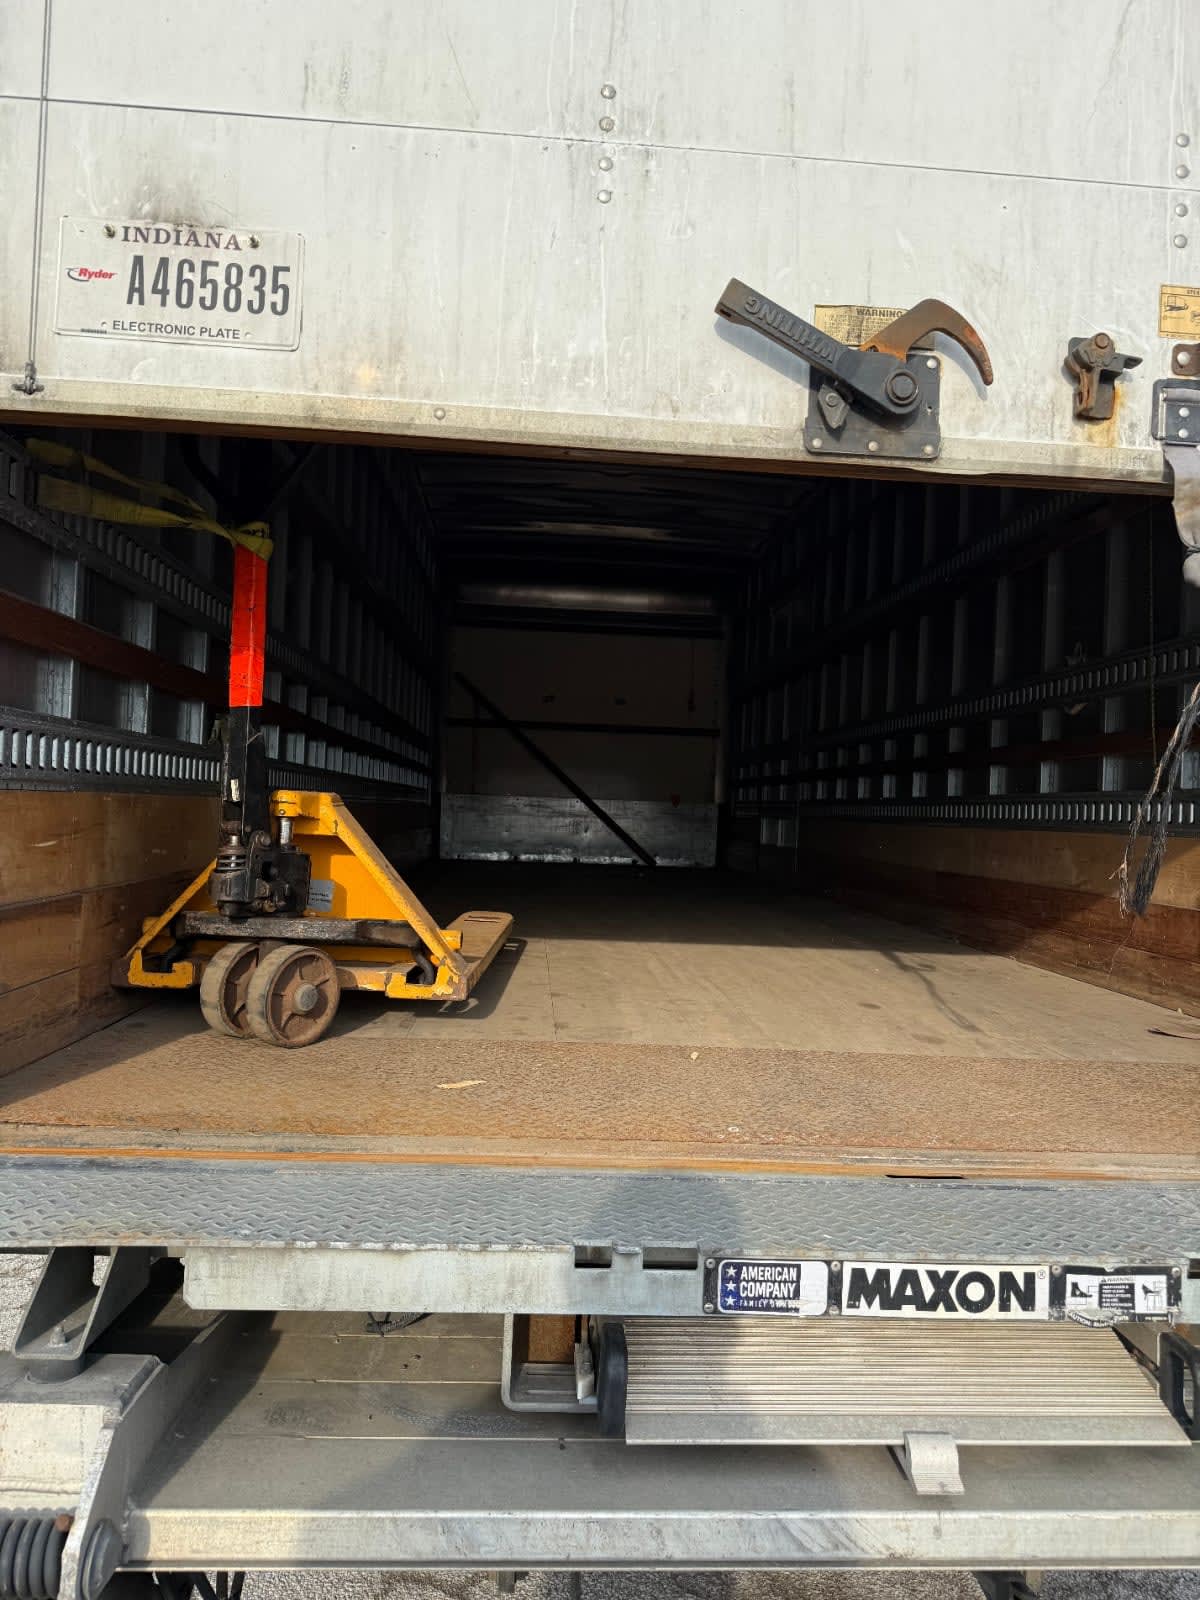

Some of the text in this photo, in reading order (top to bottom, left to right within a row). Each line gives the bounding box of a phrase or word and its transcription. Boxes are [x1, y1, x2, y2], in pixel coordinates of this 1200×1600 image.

[121, 225, 242, 251] INDIANA
[78, 267, 115, 280] Ryder
[126, 254, 291, 316] A465835
[112, 320, 241, 340] ELECTRONIC PLATE
[744, 296, 836, 363] WHITING
[740, 1265, 798, 1281] AMERICAN
[740, 1281, 797, 1298] COMPANY
